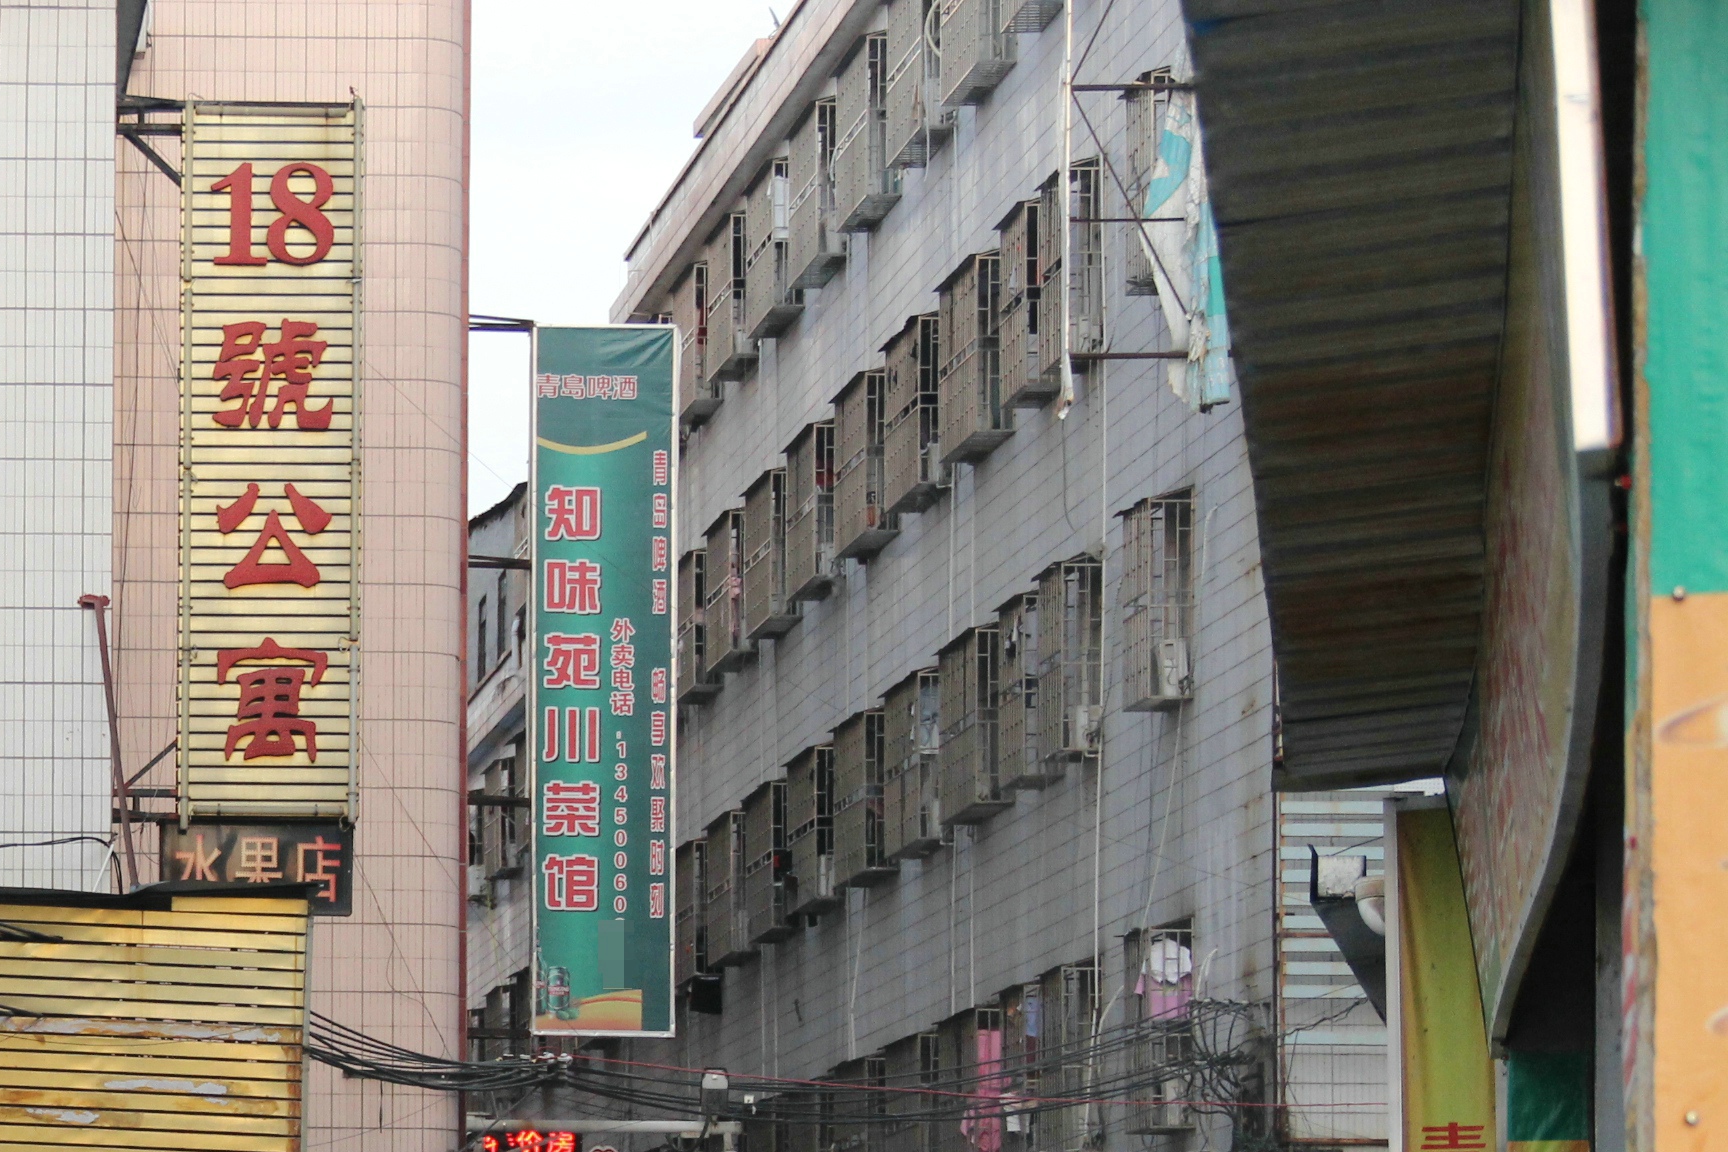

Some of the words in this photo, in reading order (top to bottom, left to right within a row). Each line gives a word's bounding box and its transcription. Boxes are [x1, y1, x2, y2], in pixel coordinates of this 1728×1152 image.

[210, 161, 335, 764] 18號公寓
[175, 834, 342, 902] 水果店
[542, 485, 602, 911] 知味苑川菜馆
